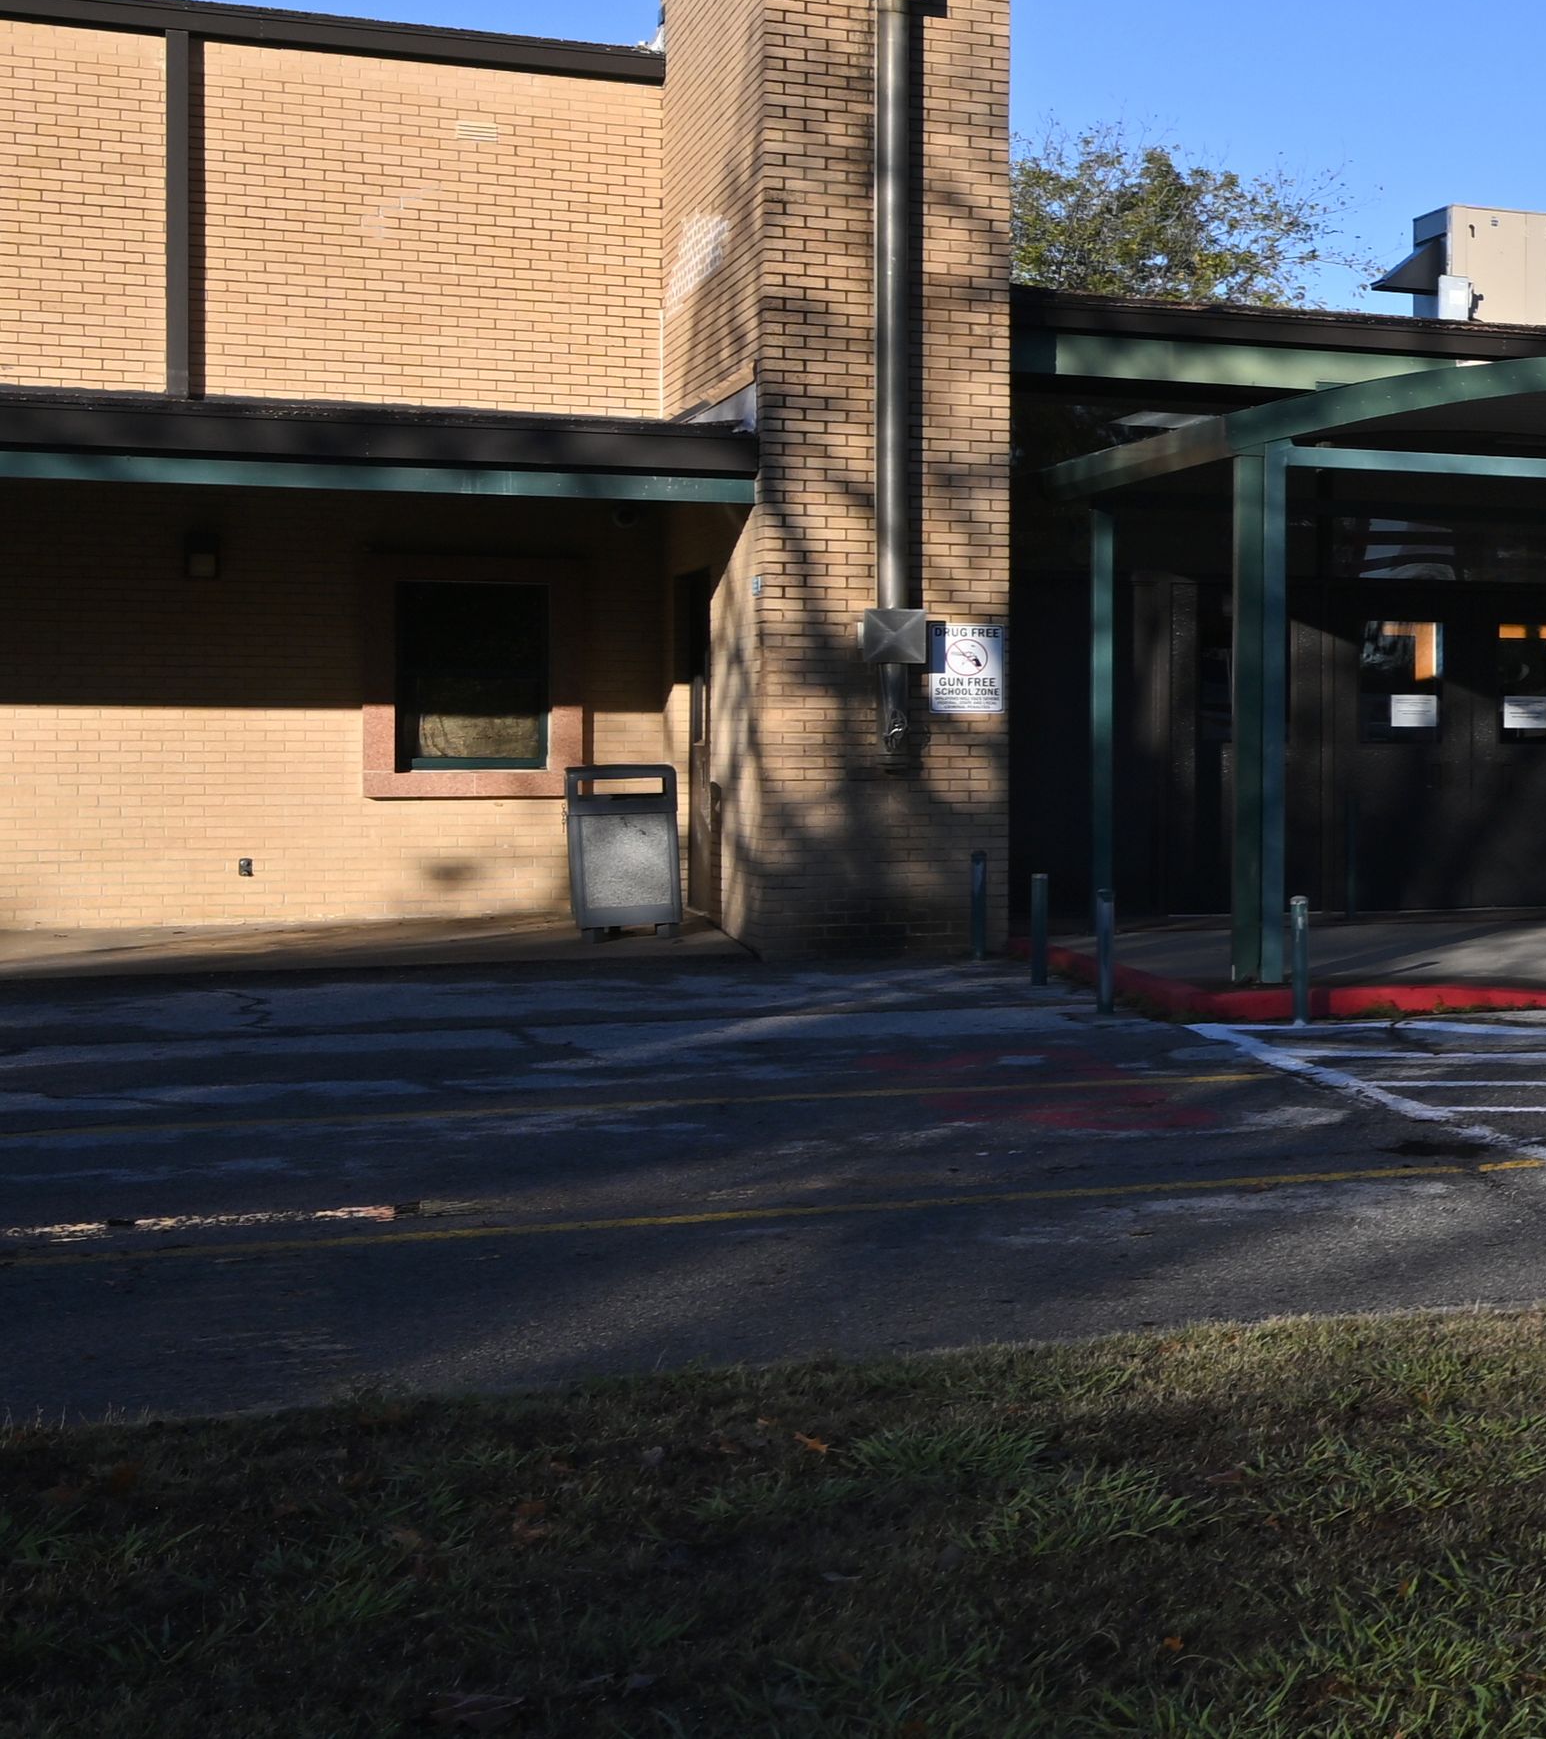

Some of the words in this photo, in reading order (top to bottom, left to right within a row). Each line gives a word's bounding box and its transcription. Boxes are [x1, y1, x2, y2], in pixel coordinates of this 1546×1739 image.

[934, 627, 968, 637] DRUG
[971, 628, 1000, 638] FREE
[938, 677, 964, 687] GUN
[967, 677, 996, 687] FREE
[934, 687, 973, 696] SCHOOL
[975, 687, 1000, 696] ZONE
